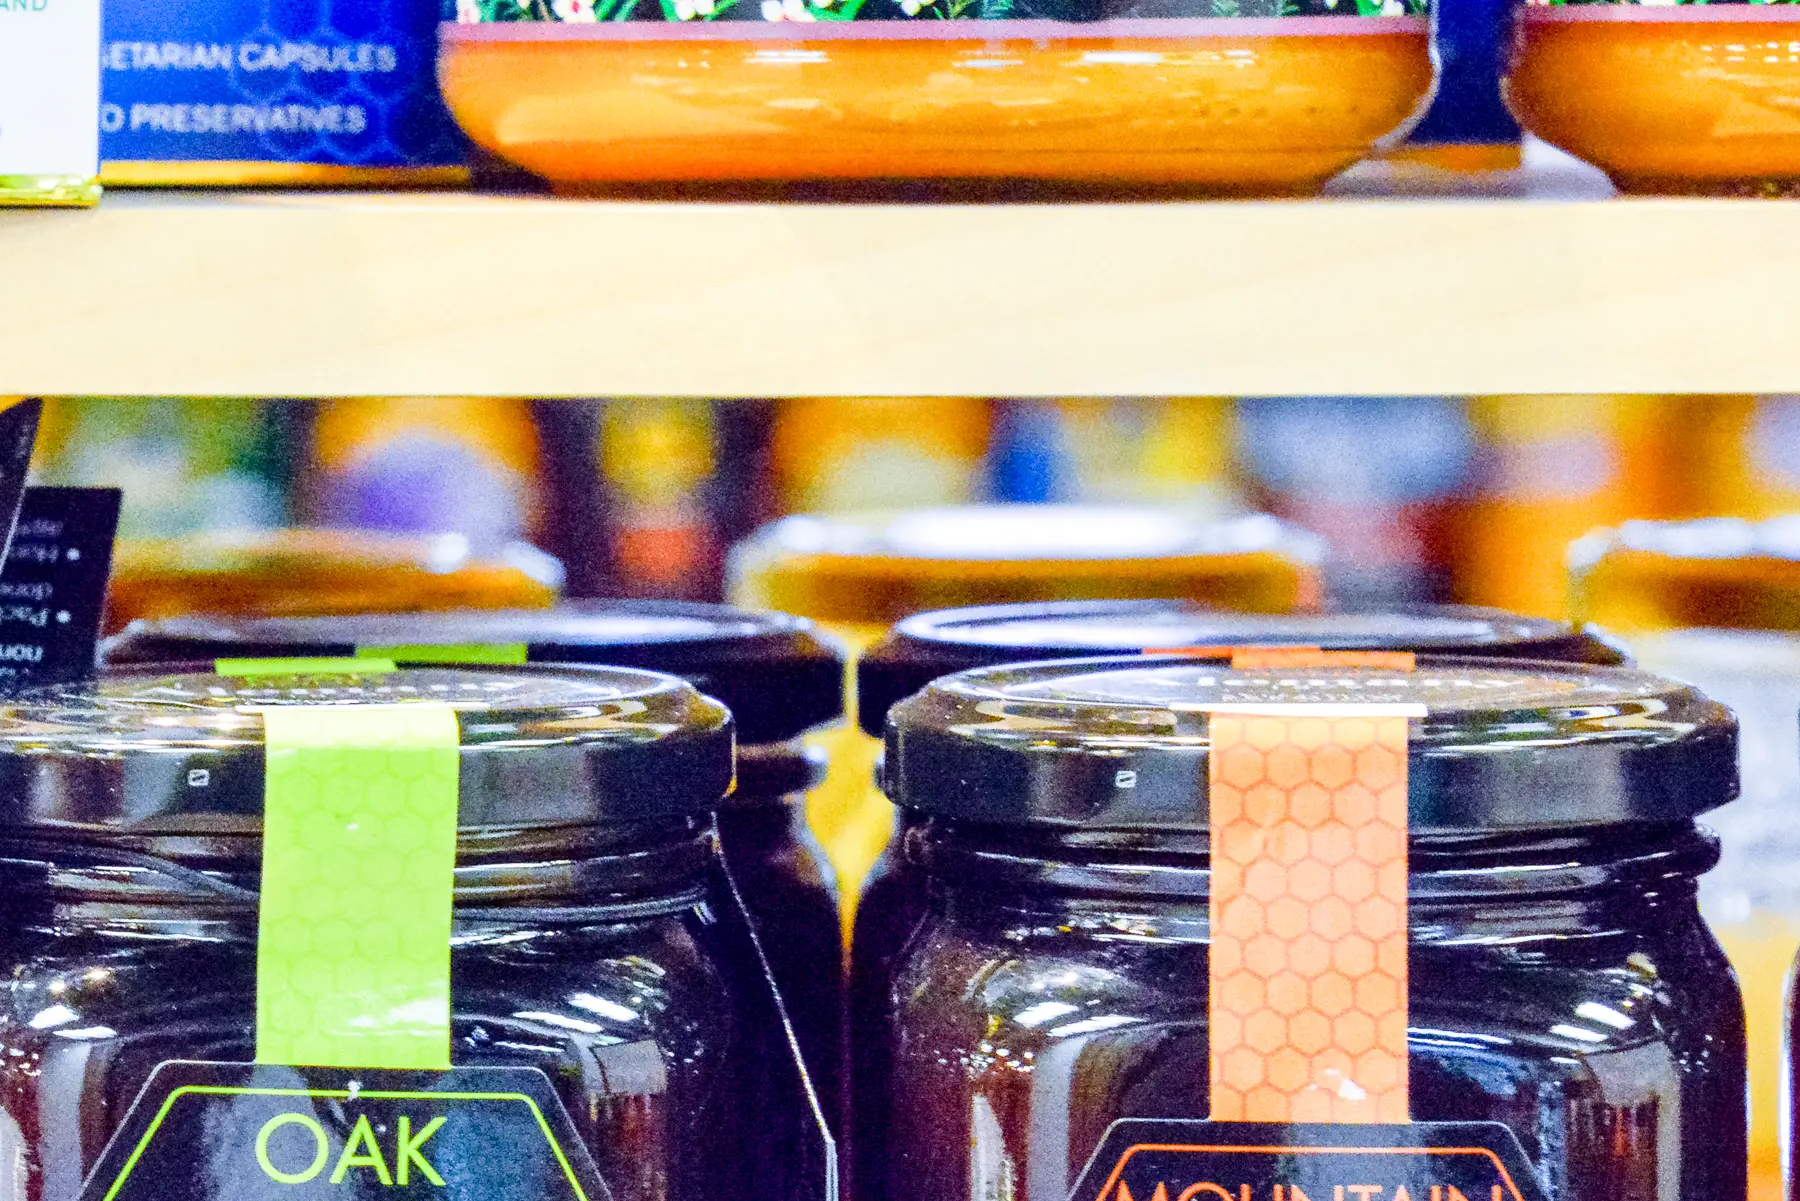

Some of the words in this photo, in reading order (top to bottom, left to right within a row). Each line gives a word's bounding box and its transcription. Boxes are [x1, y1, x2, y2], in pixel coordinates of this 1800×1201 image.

[238, 41, 397, 73] CAPSULES
[130, 103, 368, 135] PRESERVATIVES
[254, 1111, 447, 1187] OAK
